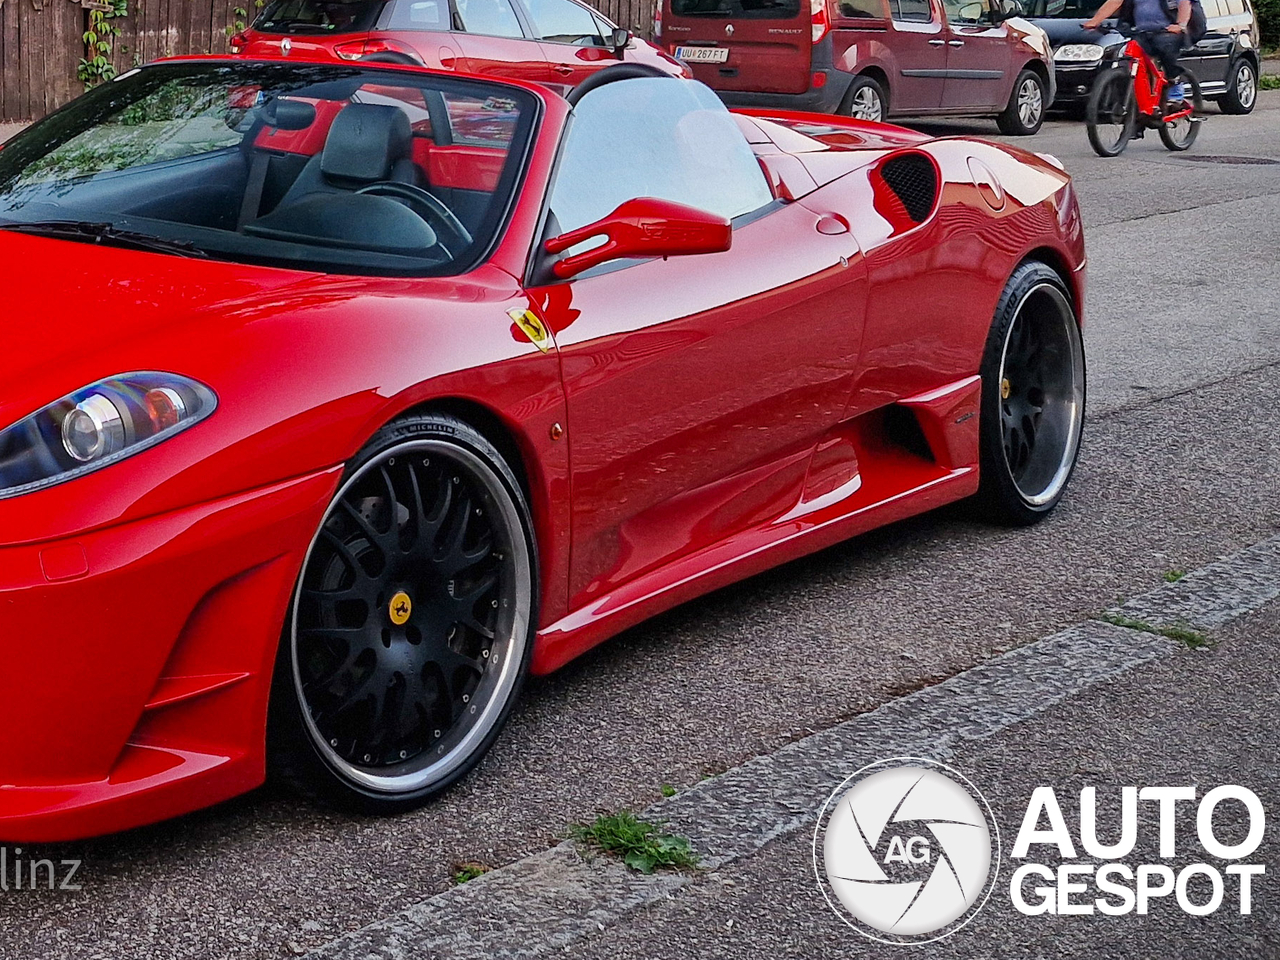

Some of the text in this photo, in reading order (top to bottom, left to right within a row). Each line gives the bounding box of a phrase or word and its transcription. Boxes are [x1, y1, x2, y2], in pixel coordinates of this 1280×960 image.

[682, 49, 692, 58] UU
[697, 49, 712, 59] 267
[409, 424, 453, 432] MICHELIN
